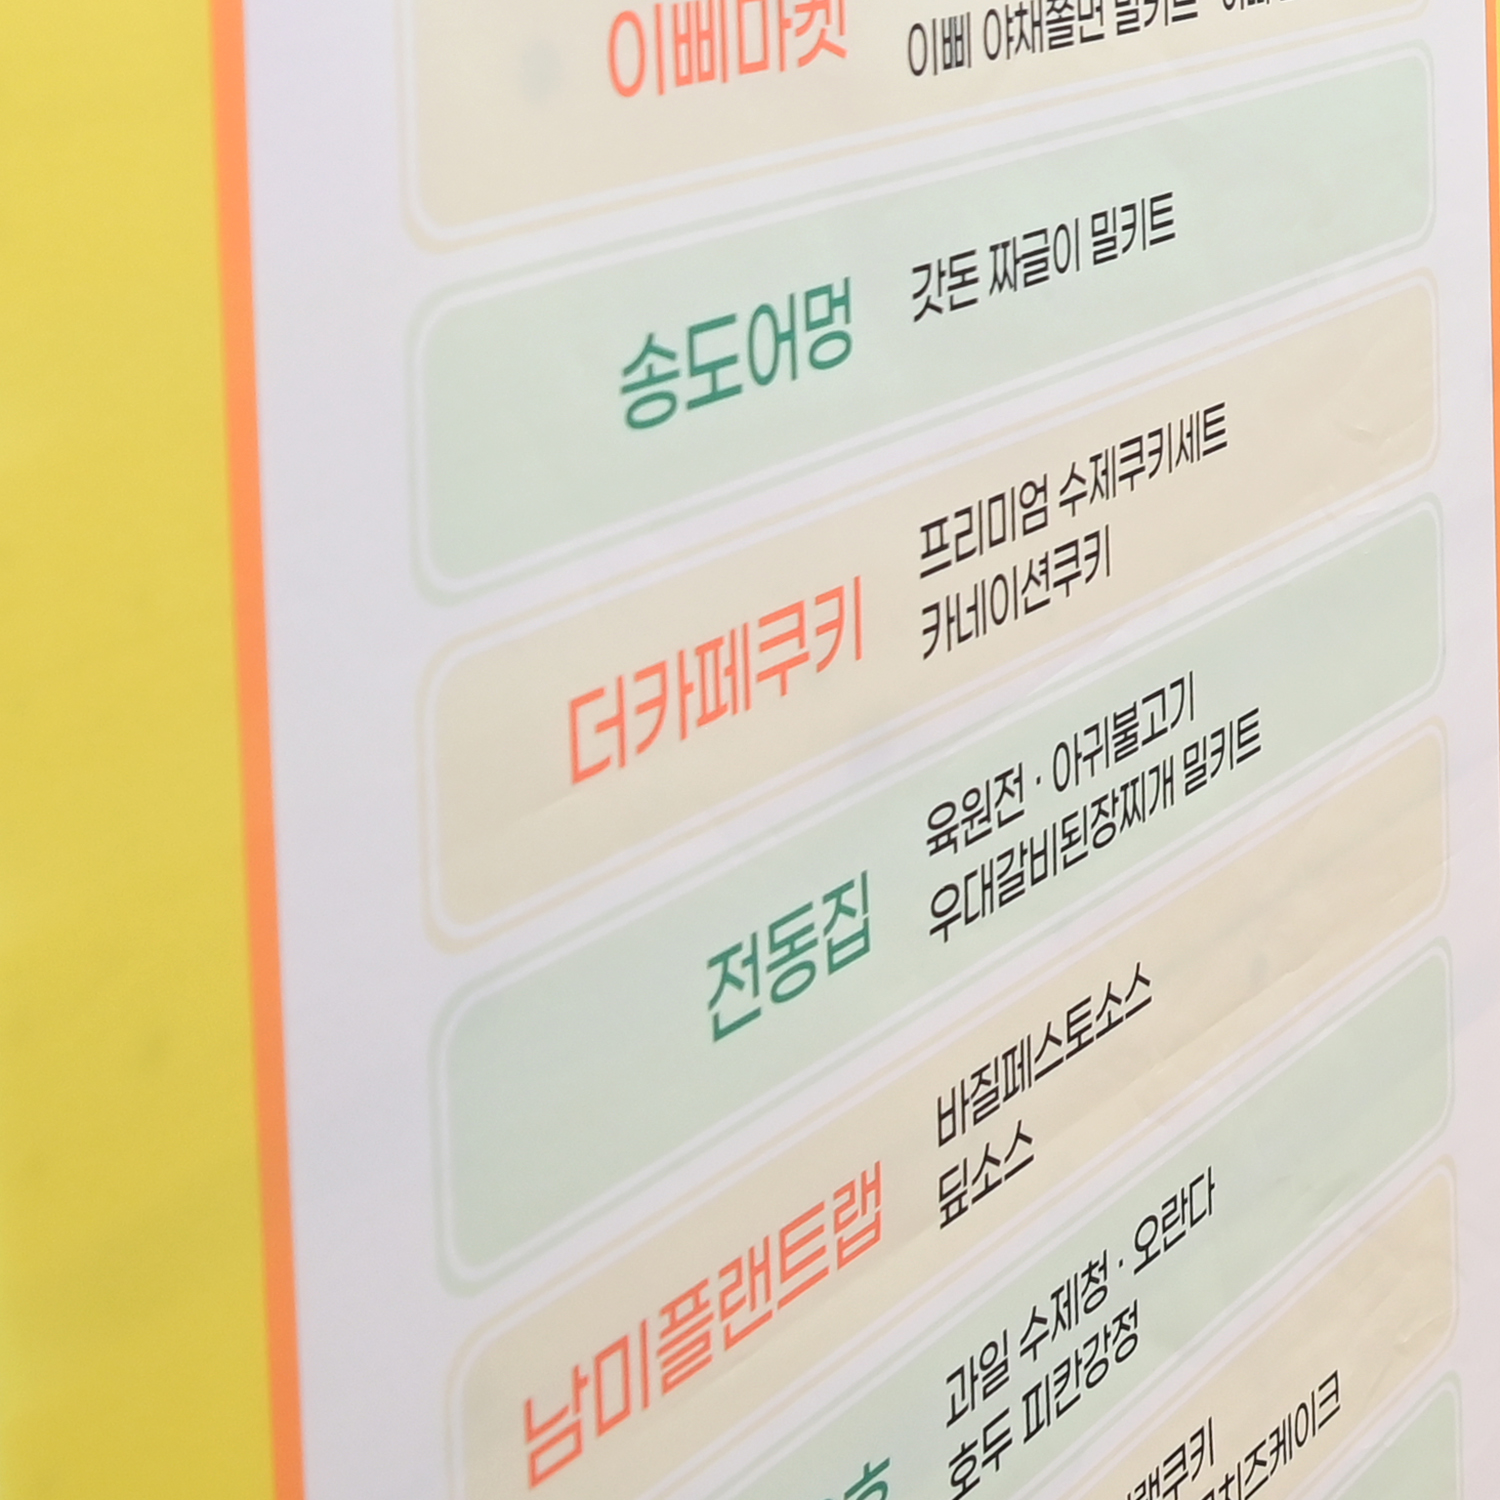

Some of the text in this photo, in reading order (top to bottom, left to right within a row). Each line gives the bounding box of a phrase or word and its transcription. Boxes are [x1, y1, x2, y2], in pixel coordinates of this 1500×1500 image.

[907, 11, 972, 77] 이삐
[911, 191, 1176, 323] 갓돈 짜글이 밀키트
[620, 276, 852, 430] 송도어멍
[919, 401, 1228, 580] 프리미엄 수제쿠키세트
[569, 575, 862, 785] 더카페쿠키
[921, 523, 1111, 661] 카네이션쿠키
[925, 761, 1025, 858] 육원전
[1052, 670, 1195, 793] 아귀불고기
[927, 706, 1262, 944] 우대갈비된장찌개 밀키트
[706, 870, 871, 1043] 전동집
[936, 961, 1153, 1148] 바질페스토소스
[938, 1120, 1035, 1230] 딮소스
[524, 1160, 882, 1488] 남미플랜트랩
[945, 1328, 1010, 1429] 과일
[1019, 1248, 1109, 1363] 수제청
[1133, 1165, 1216, 1275] 오란다
[945, 1298, 1139, 1500] 호두 피칸강정
